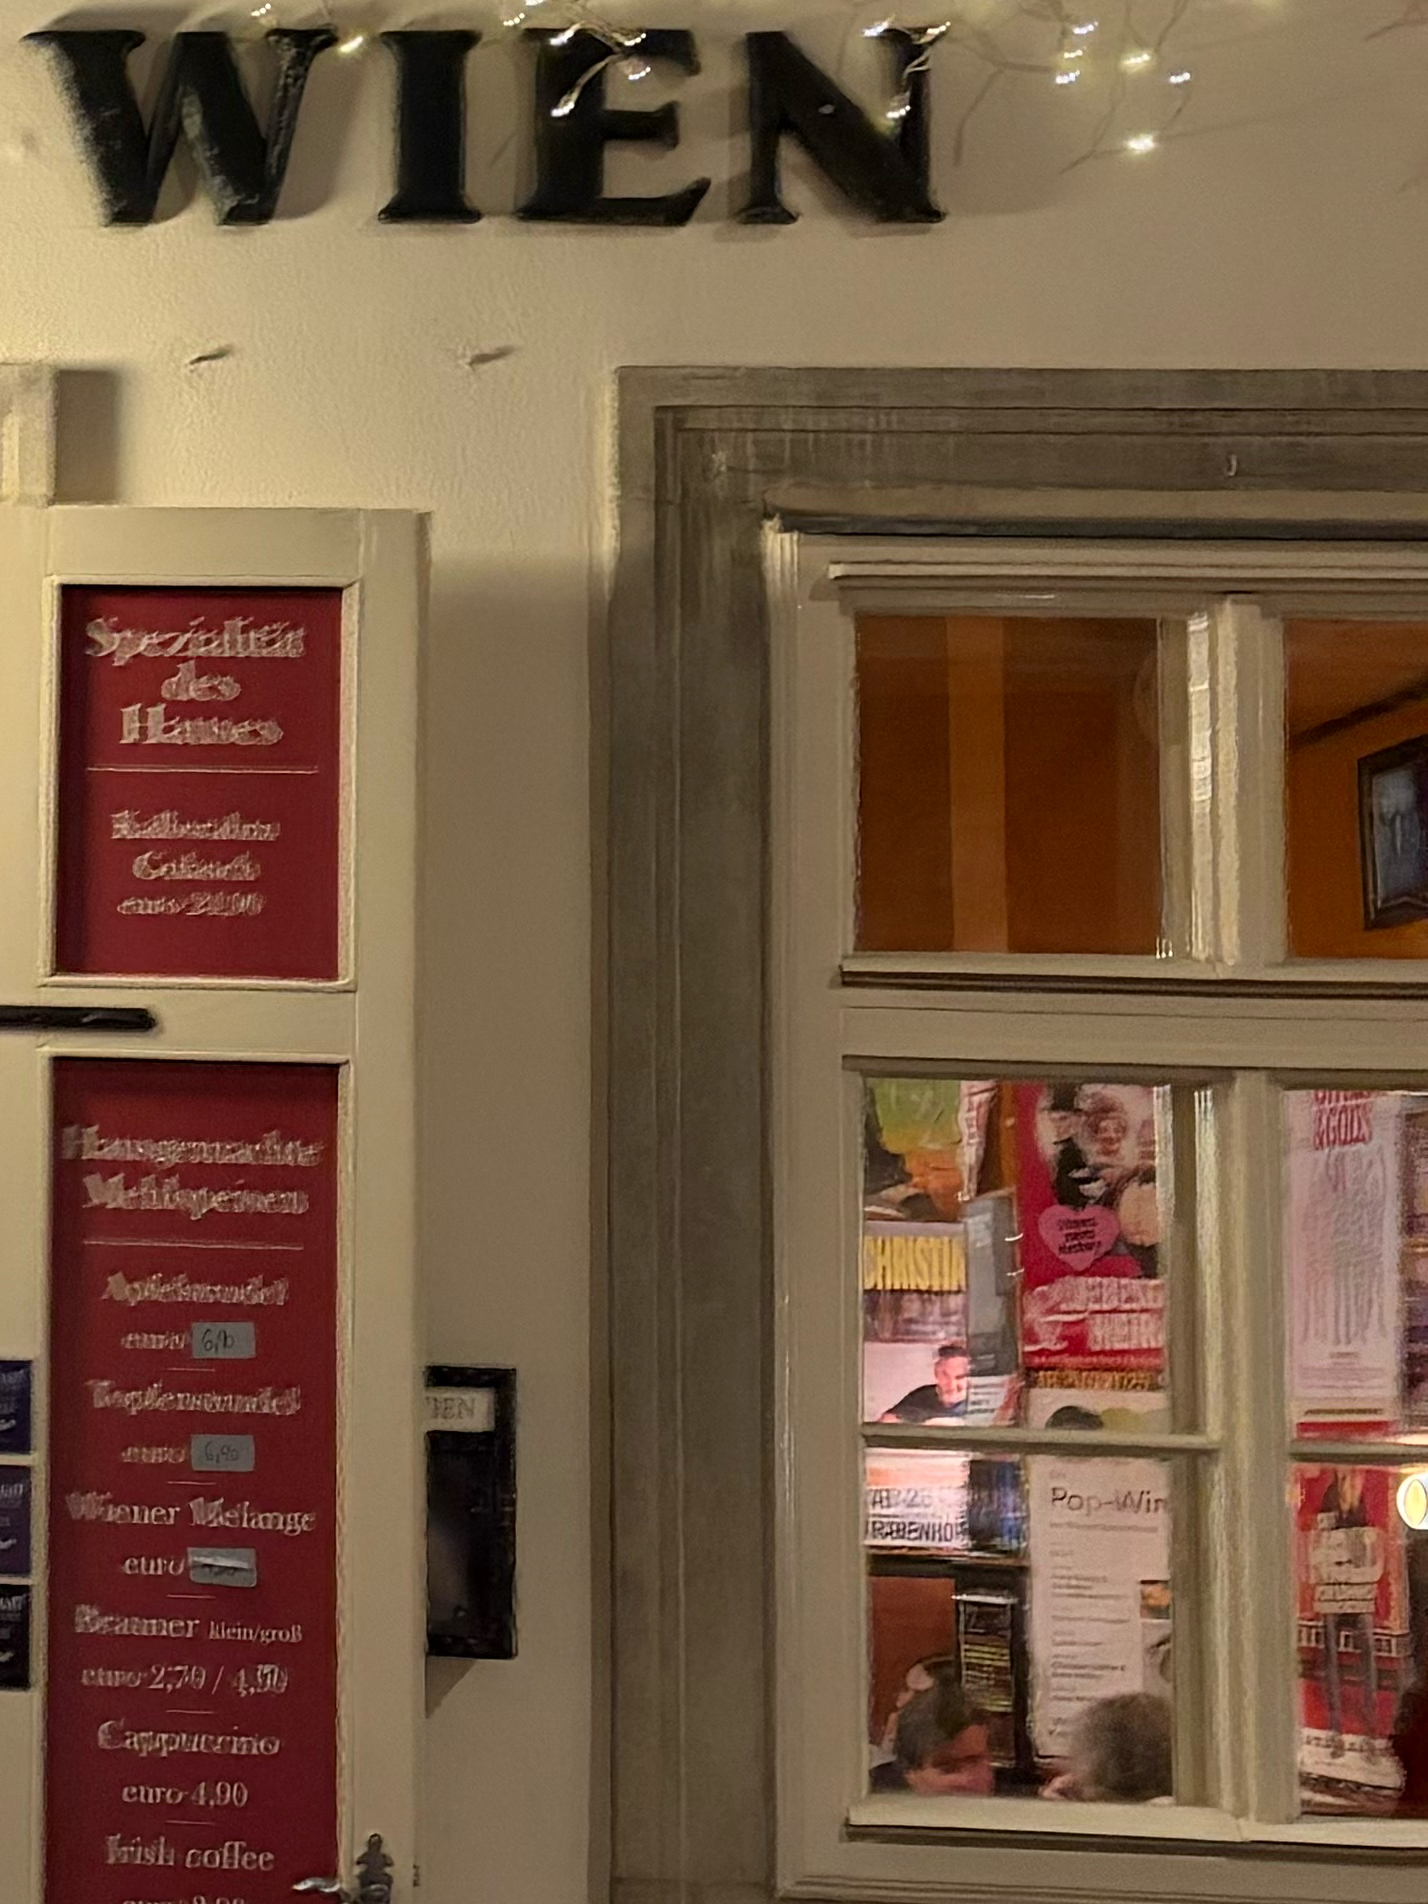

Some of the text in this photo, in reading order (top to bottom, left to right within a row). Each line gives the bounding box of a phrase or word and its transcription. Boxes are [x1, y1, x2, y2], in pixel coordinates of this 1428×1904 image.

[23, 21, 949, 227] WIEN
[189, 1496, 318, 1537] Melange
[97, 1718, 282, 1757] Cappuccino
[121, 1783, 186, 1805] euro
[105, 1833, 275, 1871] Irish coffee
